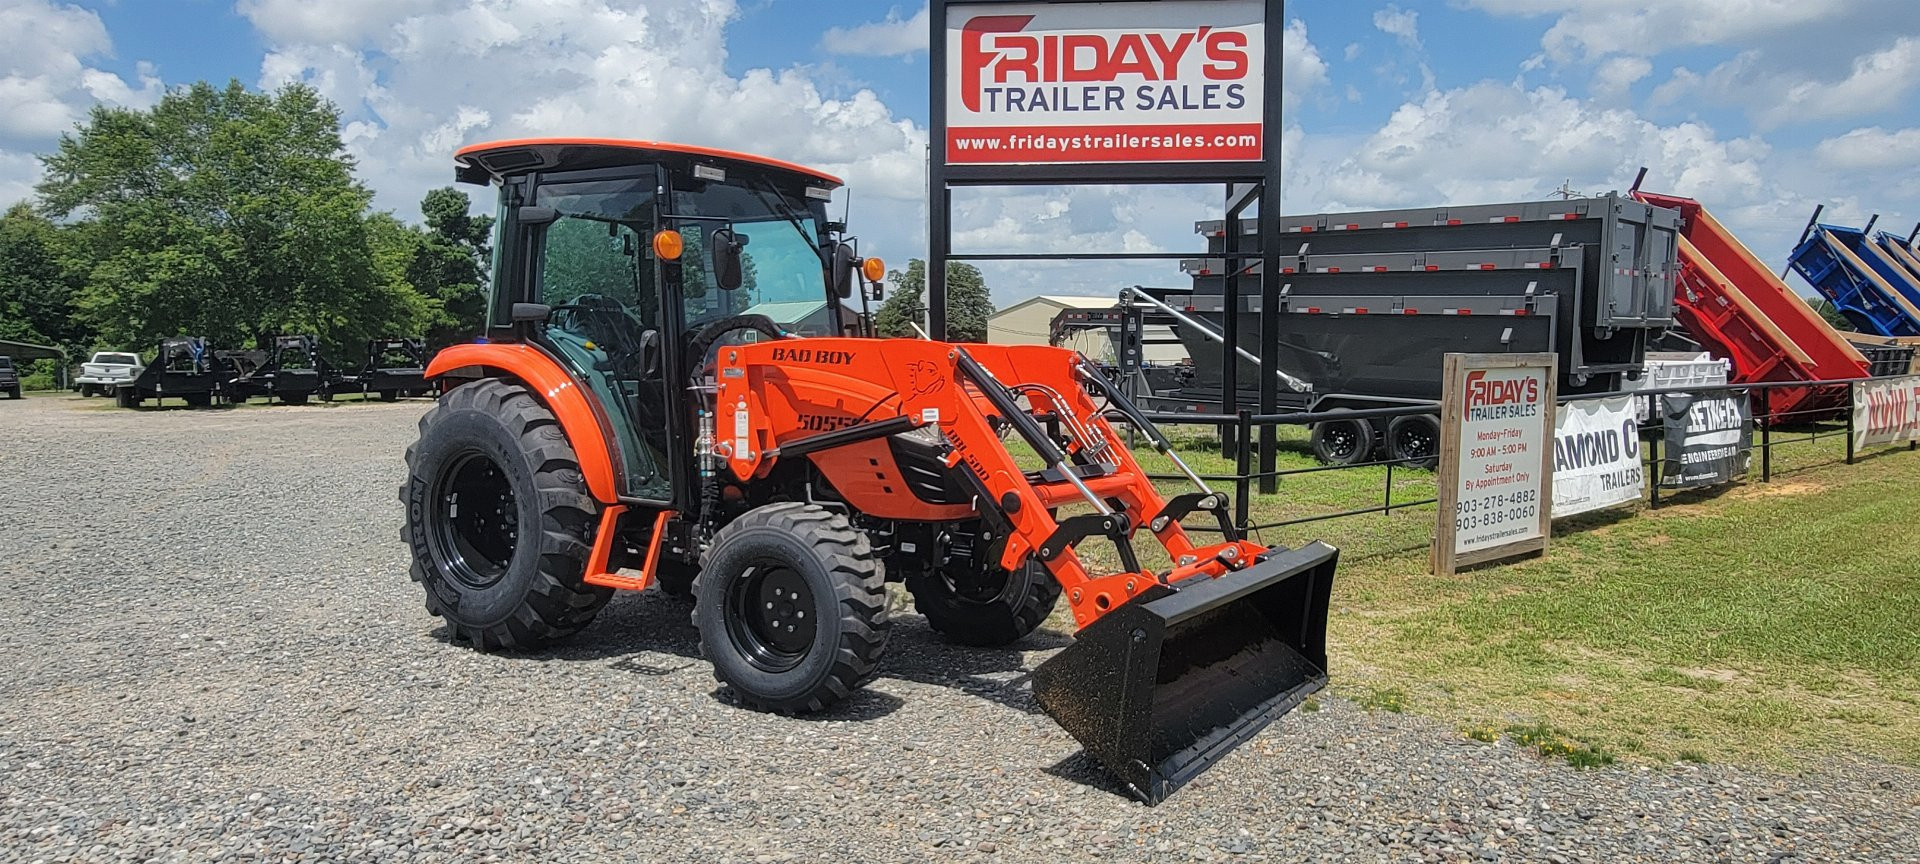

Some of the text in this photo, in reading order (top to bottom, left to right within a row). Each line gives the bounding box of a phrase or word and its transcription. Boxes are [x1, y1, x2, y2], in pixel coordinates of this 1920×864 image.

[961, 15, 1249, 112] FRIDAY'S
[984, 84, 1245, 112] TRAILER SALES
[956, 133, 1256, 151] www.fridaystrailersales.com
[772, 348, 856, 365] BAD BOY
[1464, 371, 1538, 422] FRIDAY'S
[1470, 404, 1536, 421] TRAILER SALES
[1477, 428, 1522, 441] Monday-Friday
[1553, 418, 1638, 472] AMOND C
[1471, 447, 1485, 459] 9:00
[1486, 446, 1496, 457] AM
[1502, 444, 1516, 455] 5:00
[1518, 443, 1527, 453] PM
[969, 453, 990, 481] 500
[1485, 462, 1512, 474] Saturday
[1600, 467, 1640, 491] TRAILERS
[1465, 472, 1529, 491] By Appointment Only
[1456, 489, 1535, 514] 903-278-4882
[1456, 505, 1535, 531] 903-838-0060
